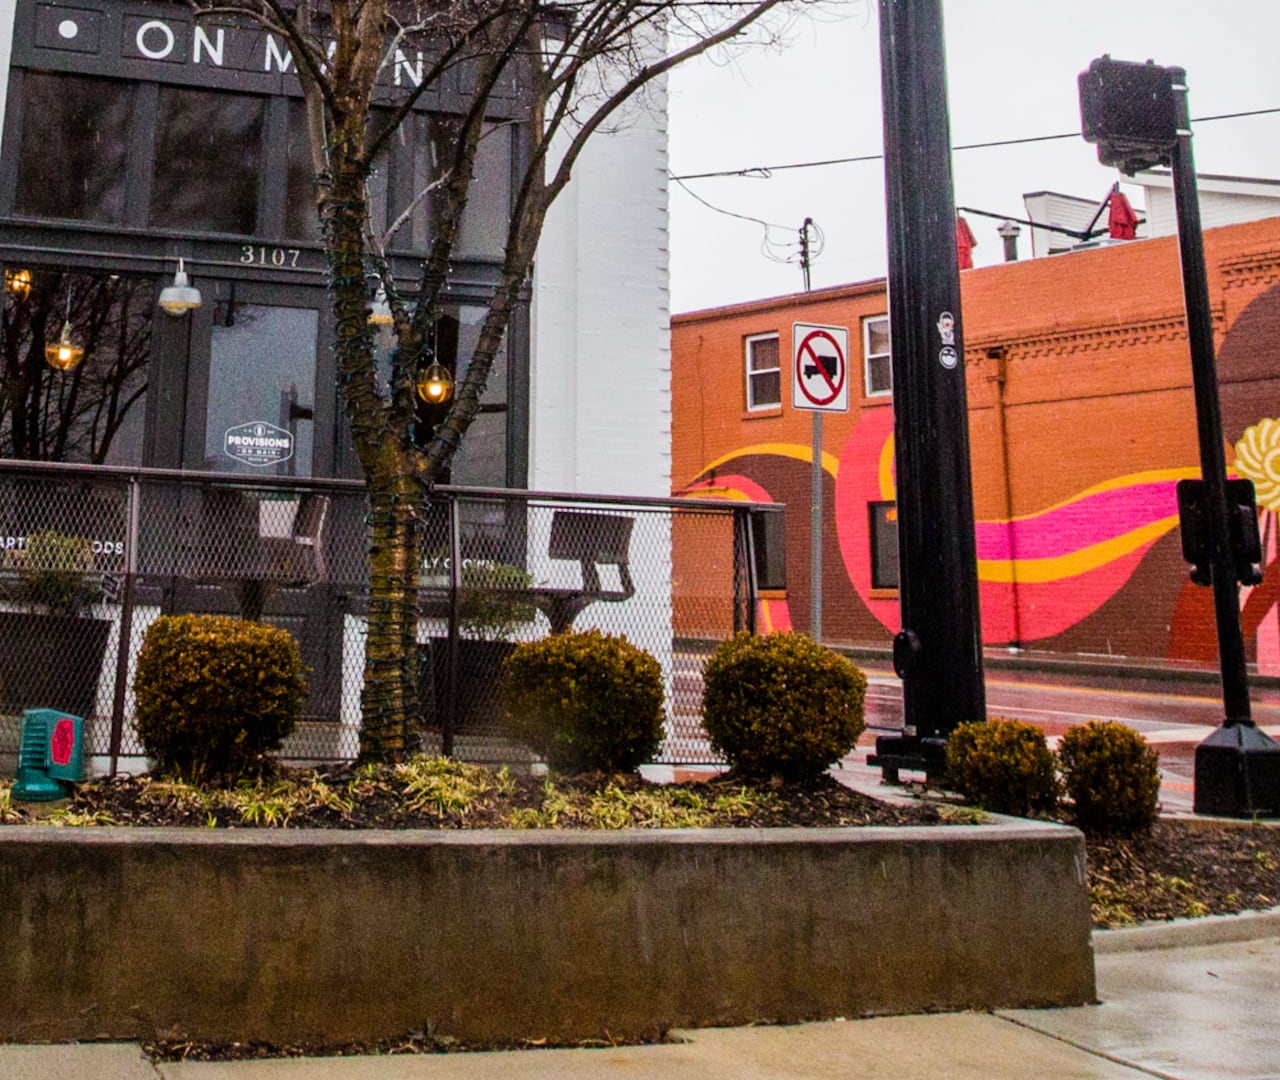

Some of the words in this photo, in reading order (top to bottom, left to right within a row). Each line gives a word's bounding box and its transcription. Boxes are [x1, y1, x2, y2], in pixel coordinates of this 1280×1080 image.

[136, 20, 225, 66] ON
[264, 33, 424, 88] MN
[240, 244, 301, 268] 3107
[228, 435, 290, 448] PROVISIONS
